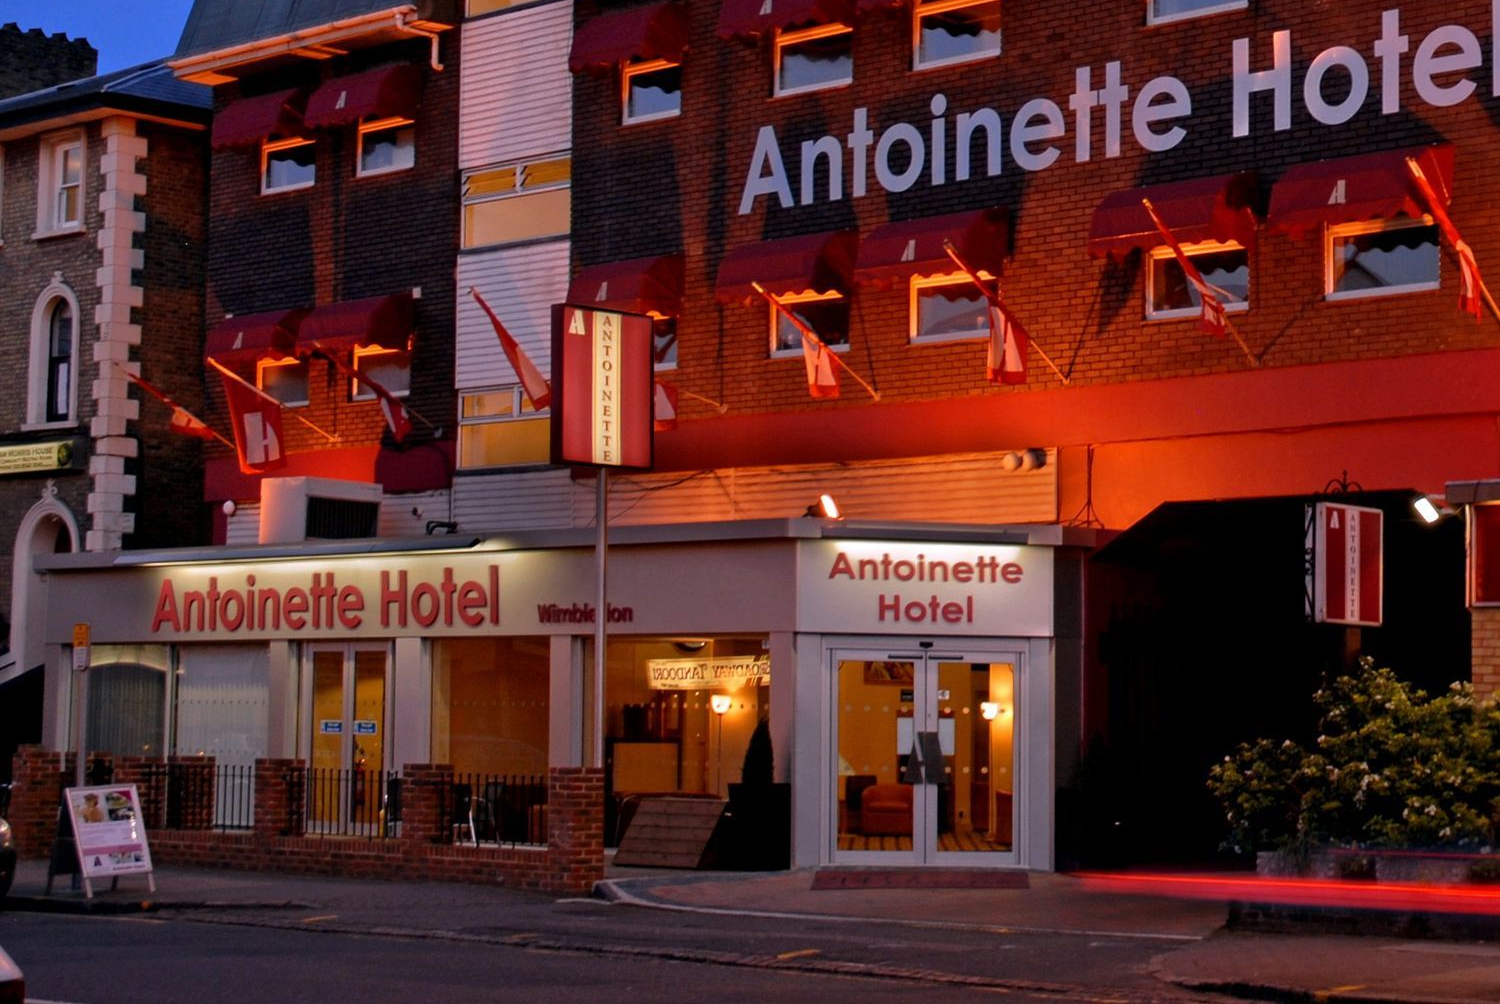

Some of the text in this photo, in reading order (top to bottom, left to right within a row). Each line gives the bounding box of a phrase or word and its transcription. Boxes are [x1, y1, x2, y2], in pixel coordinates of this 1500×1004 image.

[738, 60, 1192, 215] Antoinette
[602, 315, 613, 462] ANTOINETTE
[152, 564, 500, 633] Antoinette Hotel
[828, 552, 1024, 584] Antoinette
[878, 594, 974, 623] Hotel
[1349, 514, 1357, 619] ANTOINETTE
